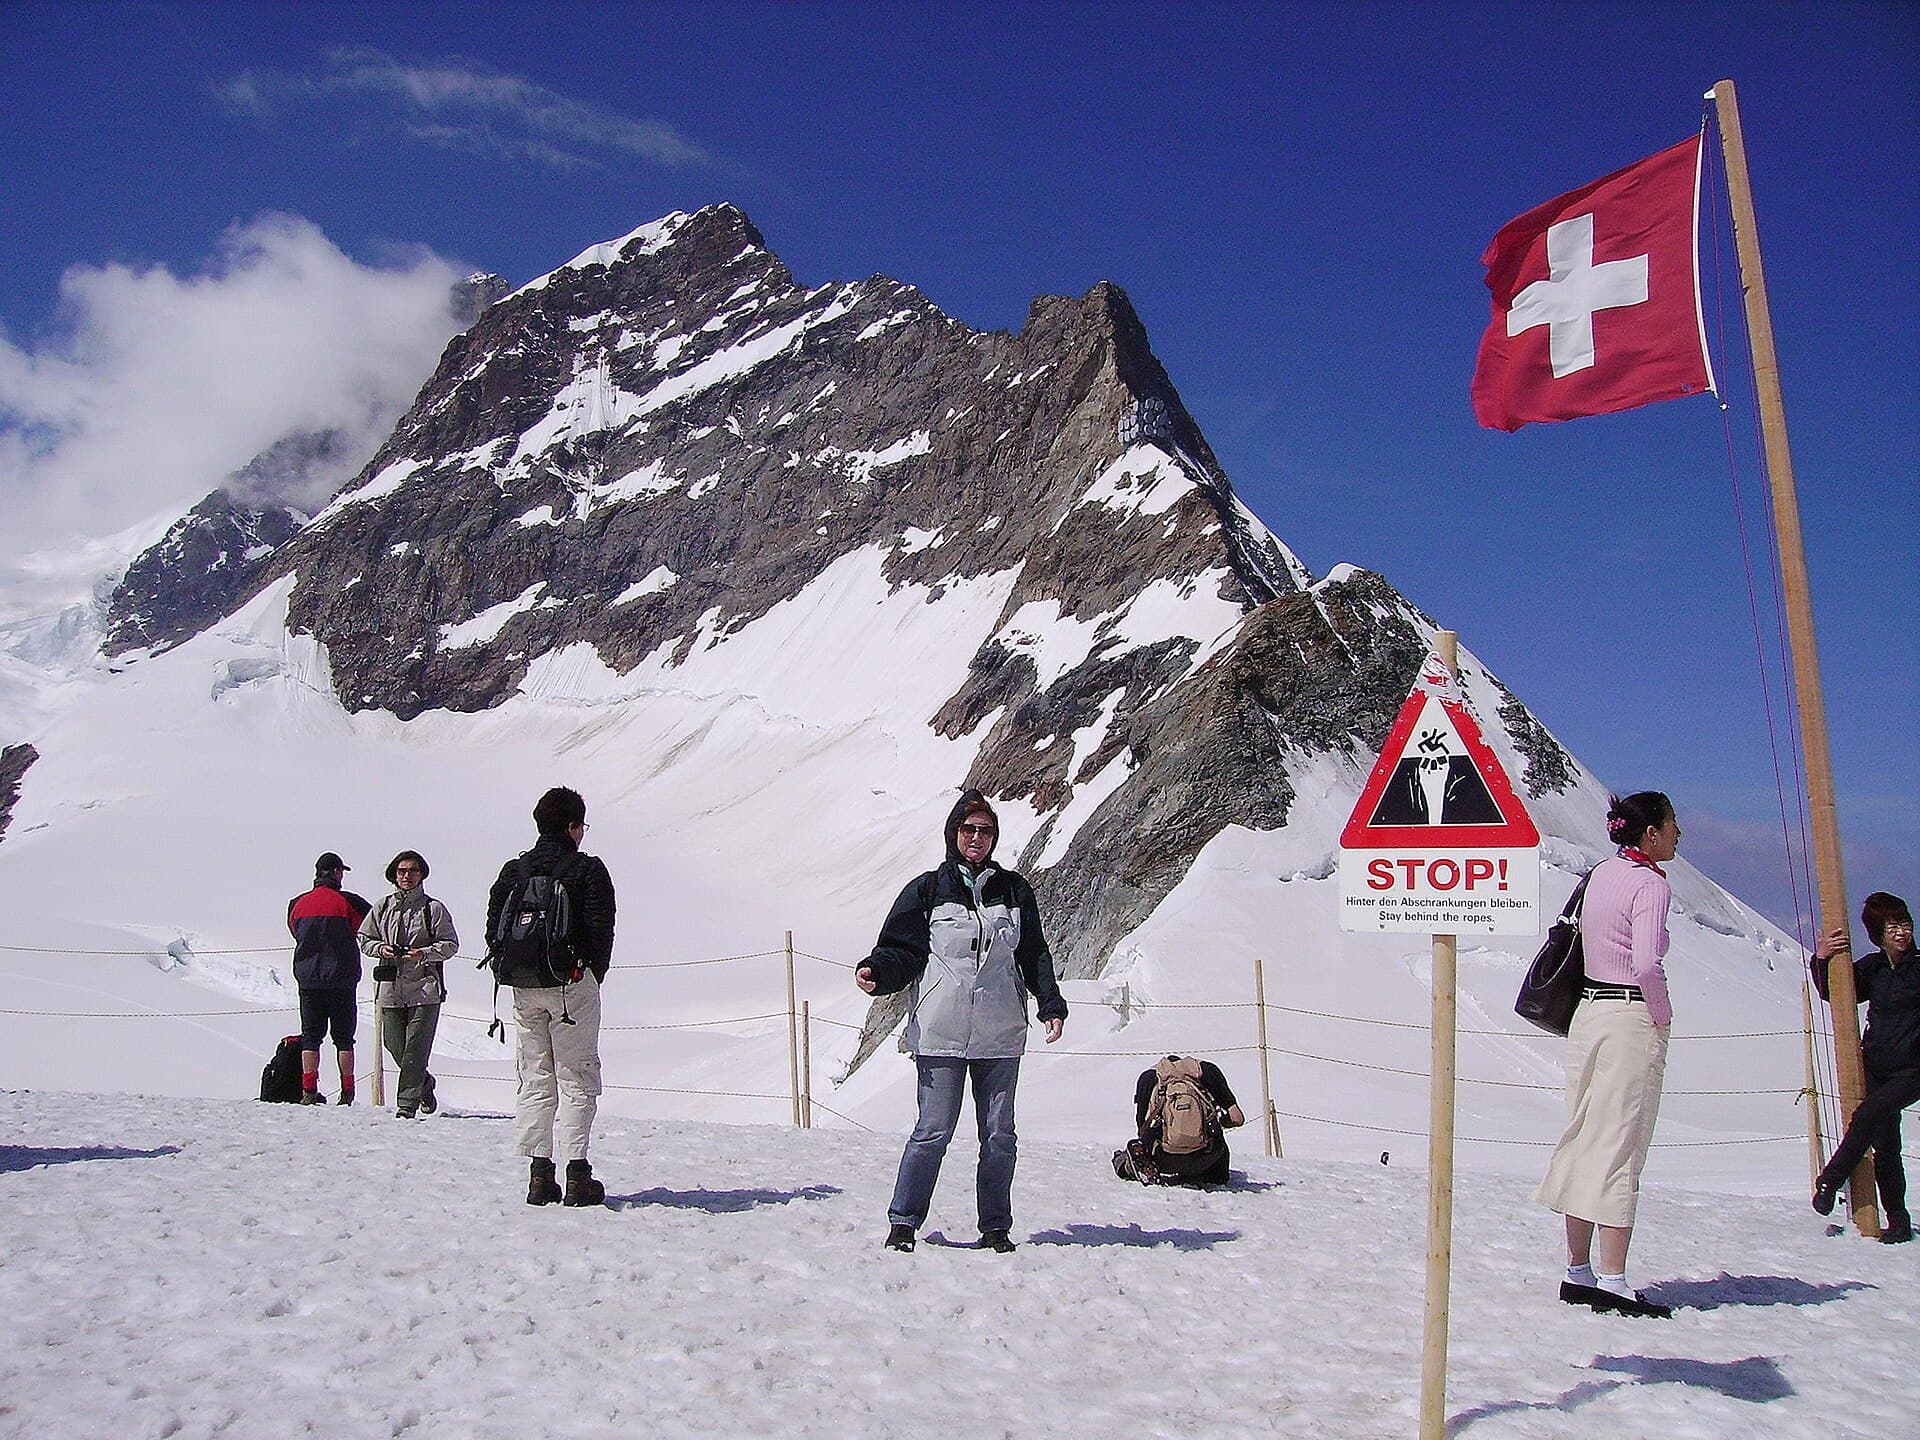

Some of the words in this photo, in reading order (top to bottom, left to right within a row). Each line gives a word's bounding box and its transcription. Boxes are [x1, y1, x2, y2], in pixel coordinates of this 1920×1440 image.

[1367, 858, 1508, 891] STOP!
[1346, 896, 1376, 907] Hinter
[1379, 896, 1398, 907] den
[1400, 897, 1487, 910] Abschrankungen
[1490, 898, 1532, 909] bleiben.
[1379, 910, 1402, 923] Stay
[1404, 911, 1439, 921] behind
[1442, 912, 1460, 922] the
[1463, 914, 1495, 924] ropes.
